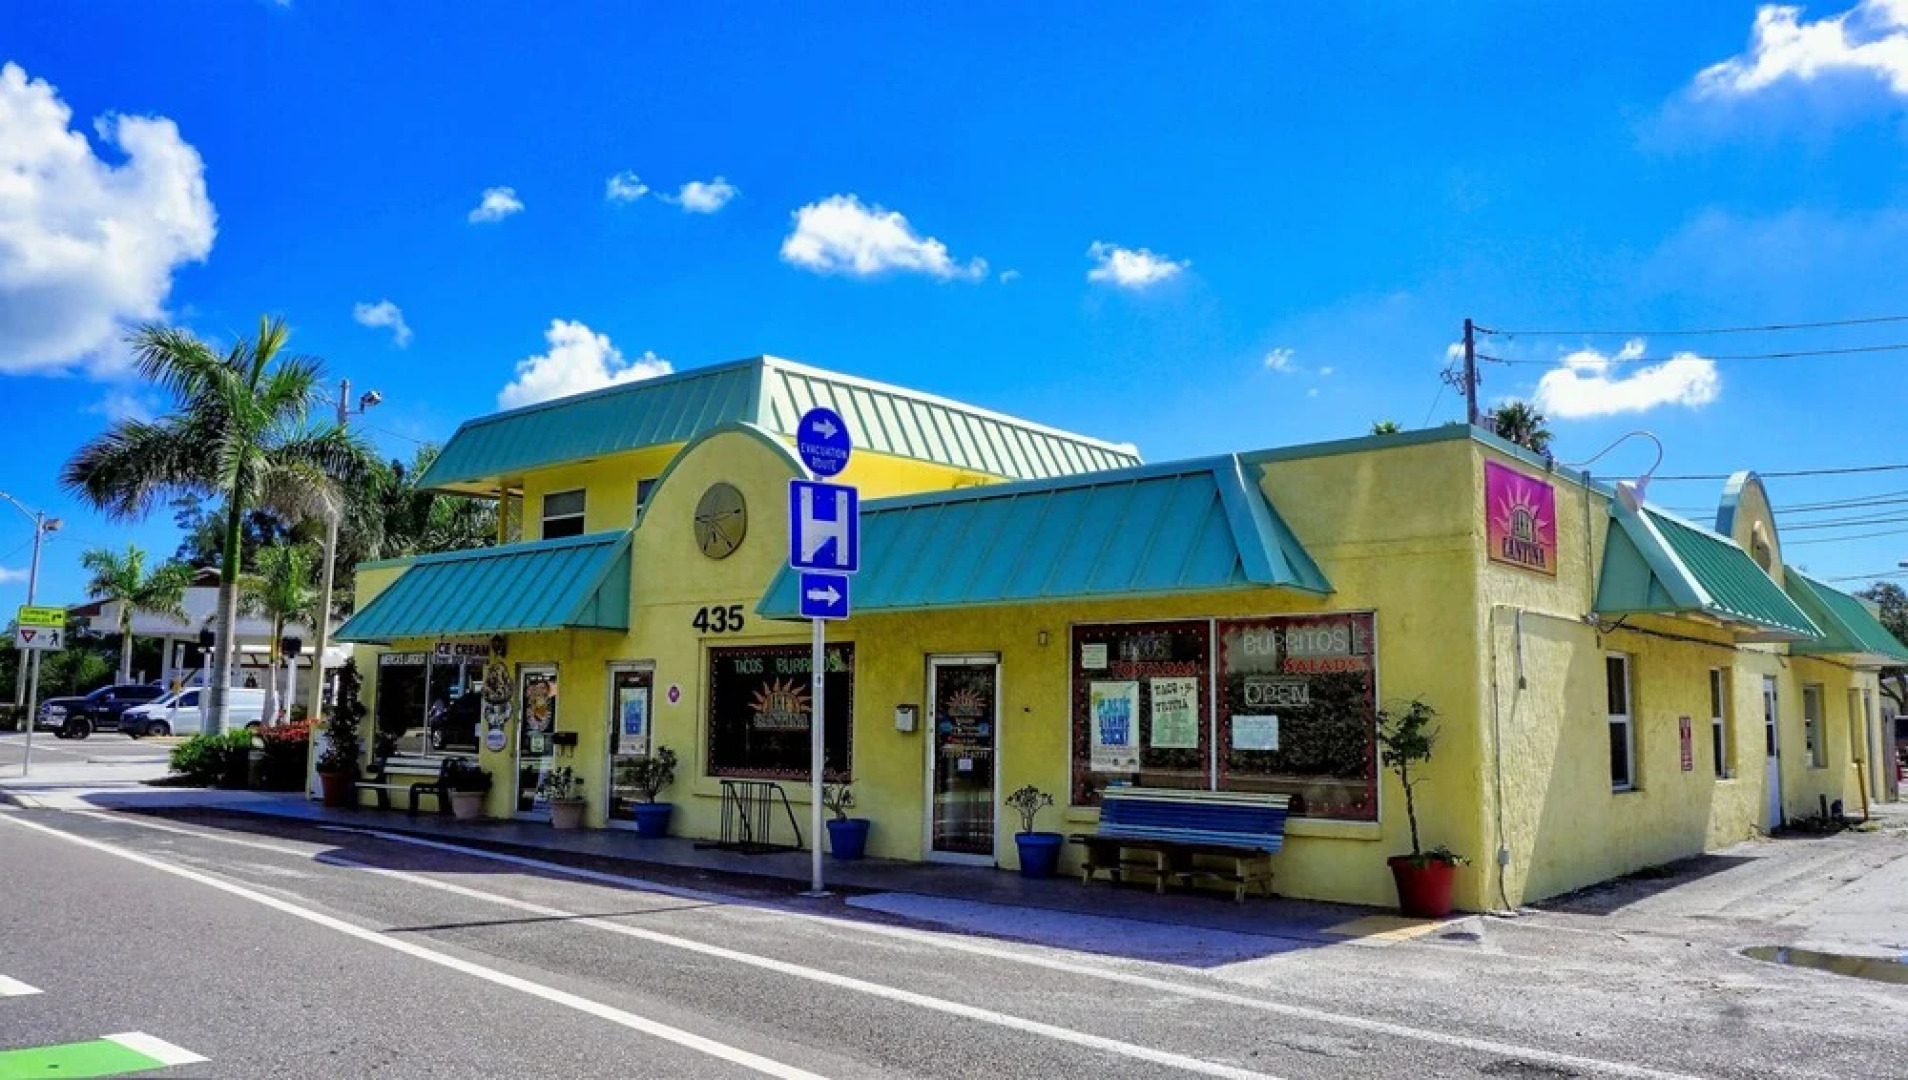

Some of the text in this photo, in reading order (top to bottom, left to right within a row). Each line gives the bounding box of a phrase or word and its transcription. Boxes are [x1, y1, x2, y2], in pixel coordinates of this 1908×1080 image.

[801, 442, 847, 458] EVACUATION
[801, 487, 848, 565] H
[1502, 537, 1546, 569] CANTINA
[692, 605, 744, 633] 435
[435, 643, 490, 656] ICE CREAM
[1243, 630, 1346, 654] BURRITOS
[734, 658, 763, 673] TACOS
[1112, 661, 1197, 677] TOSTADAS
[1284, 658, 1358, 673] SALADS
[1246, 685, 1308, 704] OPEN
